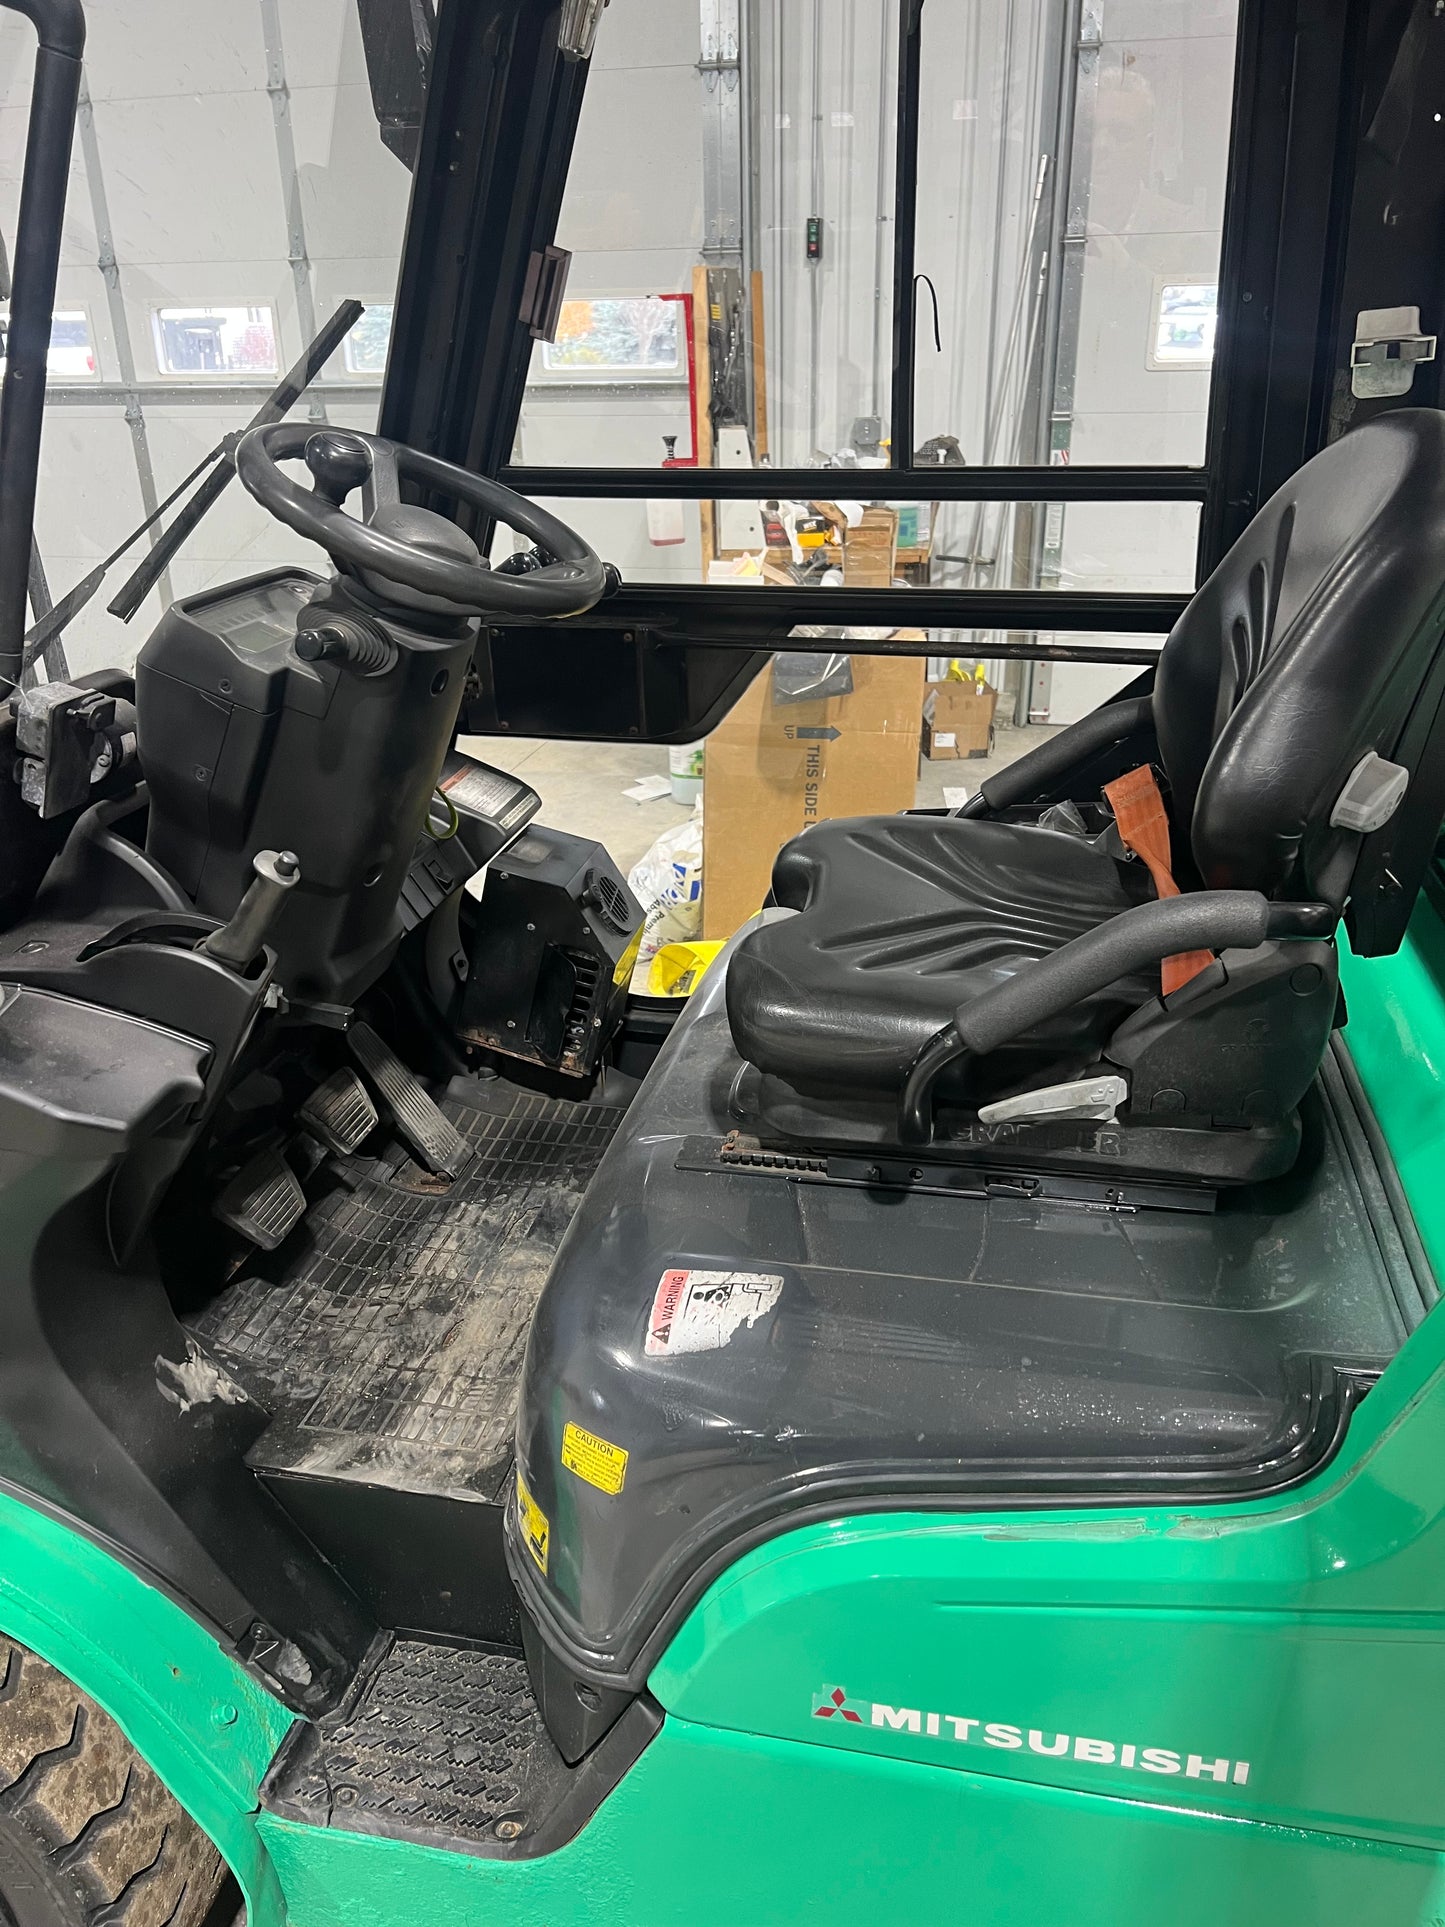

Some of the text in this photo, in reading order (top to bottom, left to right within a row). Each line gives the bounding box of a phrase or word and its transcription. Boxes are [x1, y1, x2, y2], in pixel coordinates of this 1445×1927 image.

[784, 724, 794, 740] UP
[806, 744, 821, 779] THIS
[804, 782, 819, 817] SIDE
[643, 911, 665, 936] Premi
[661, 1276, 684, 1321] WARNING
[575, 1430, 614, 1457] CAUTION
[871, 1703, 1250, 1785] MITSUBISHI
